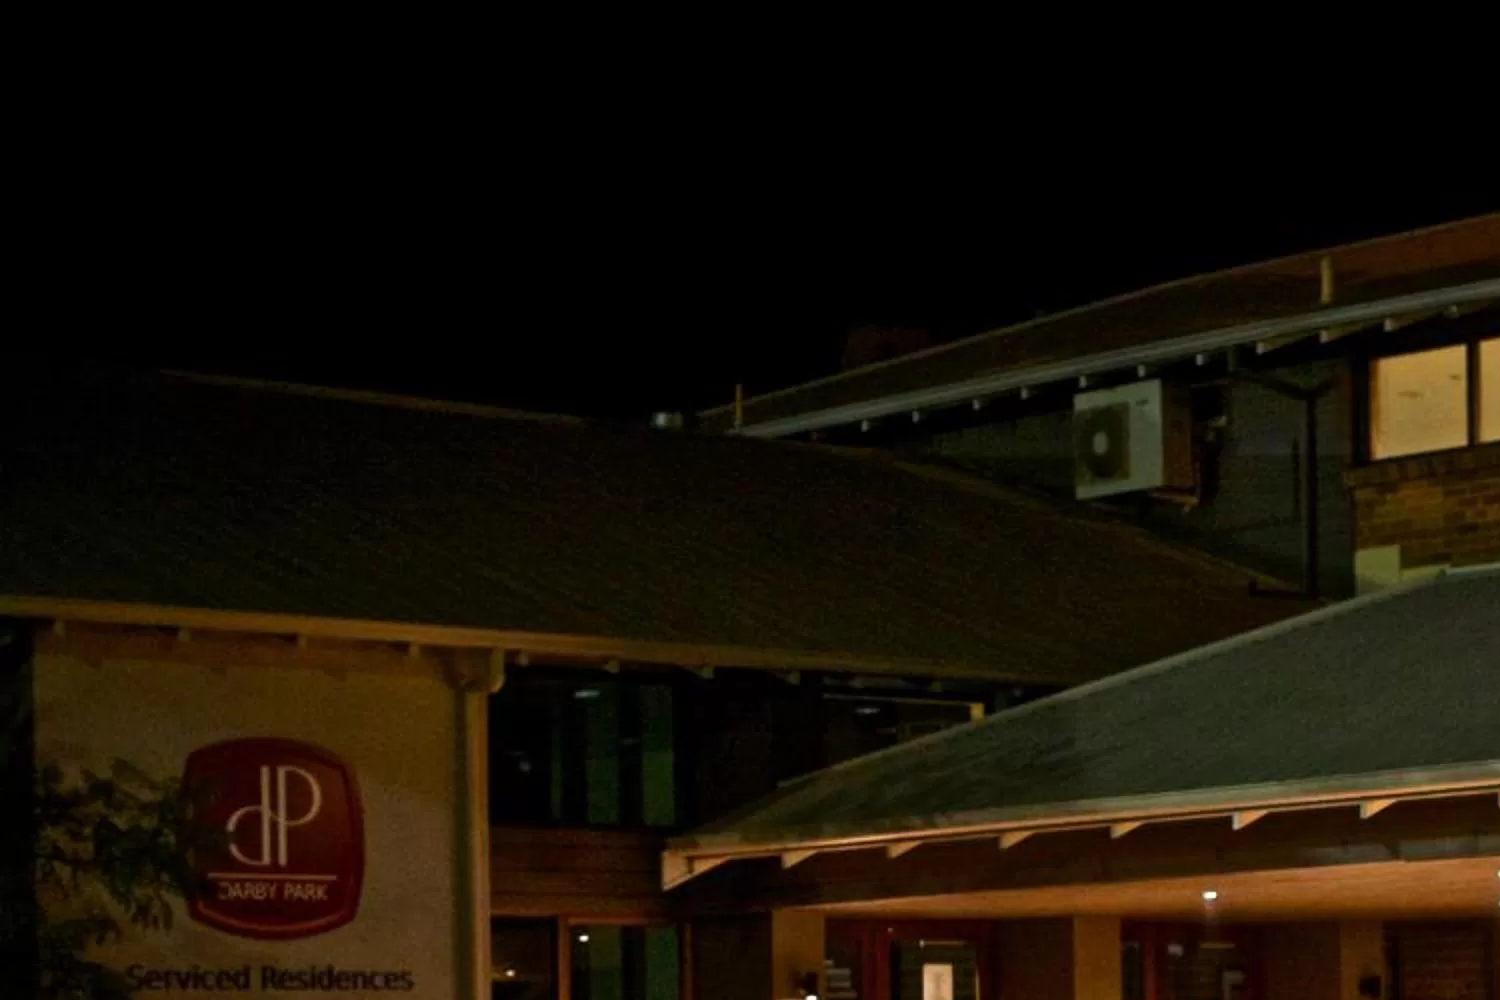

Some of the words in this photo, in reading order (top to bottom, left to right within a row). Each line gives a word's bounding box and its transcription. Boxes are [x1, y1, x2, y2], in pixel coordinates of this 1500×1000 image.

[216, 881, 277, 900] DARBY
[283, 881, 328, 900] PARK
[126, 963, 250, 992] Serviced
[261, 964, 414, 992] Residences
